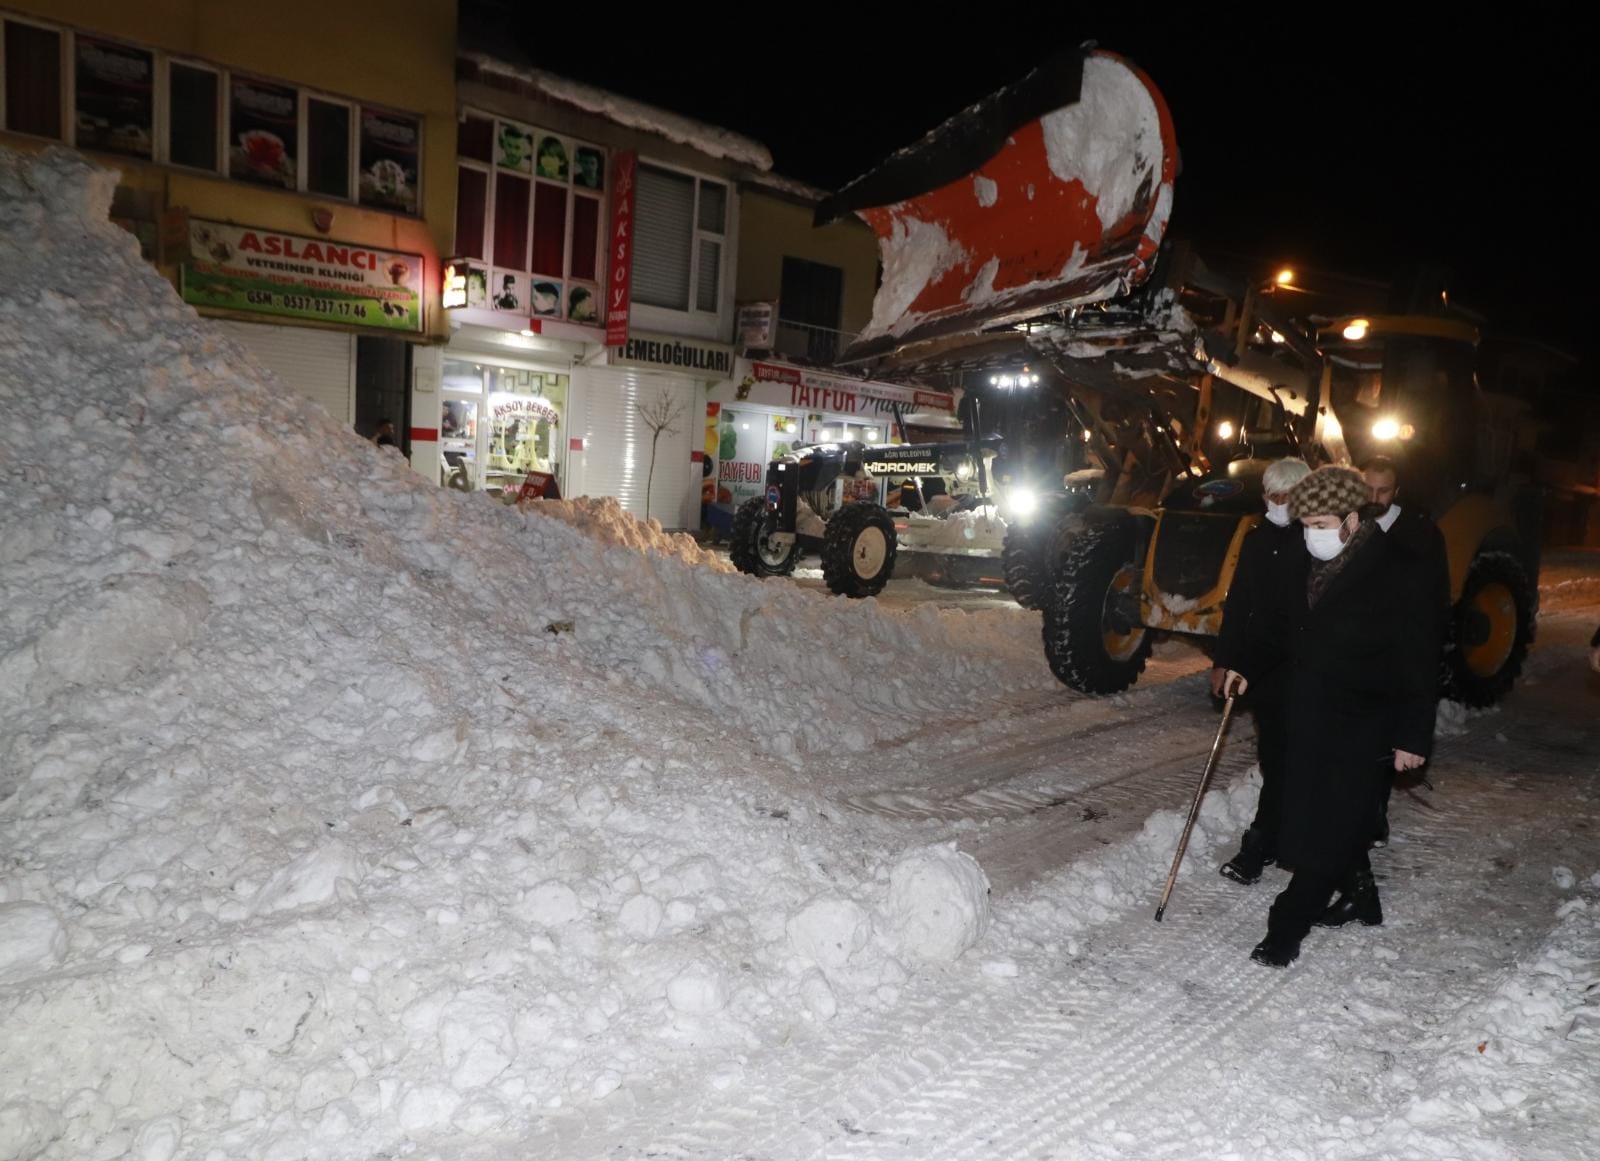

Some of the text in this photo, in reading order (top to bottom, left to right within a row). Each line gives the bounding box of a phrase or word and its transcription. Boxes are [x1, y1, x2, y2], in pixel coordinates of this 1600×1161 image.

[239, 232, 376, 270] ASLANCI
[247, 257, 314, 274] VETERİNER
[247, 290, 273, 306] GSM
[283, 294, 311, 311] 0537
[338, 303, 350, 316] 17
[353, 305, 367, 318] 46
[493, 399, 559, 426] AKSOY BERBER
[791, 383, 856, 413] TAYFUR
[860, 393, 921, 417] Maav
[719, 460, 762, 483] TAYFUR
